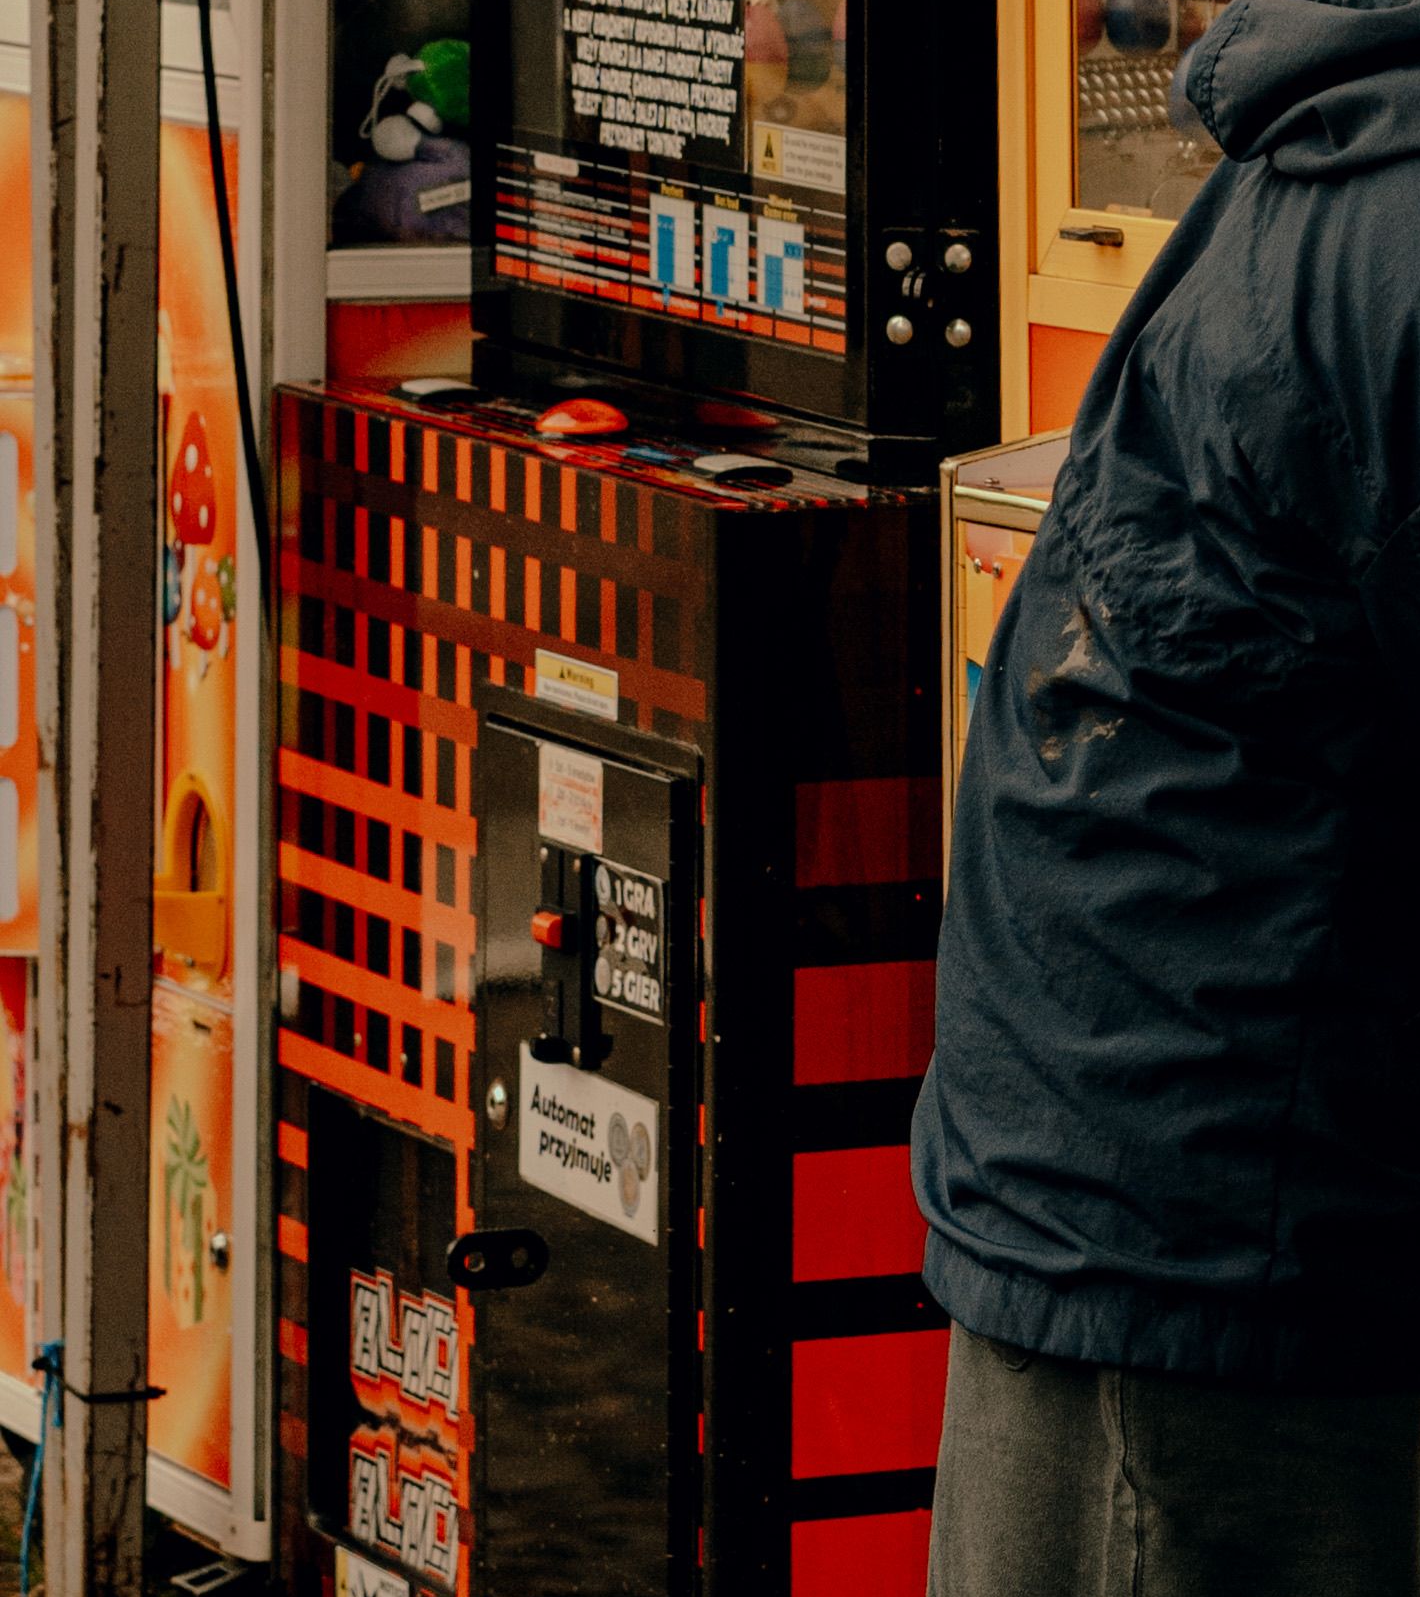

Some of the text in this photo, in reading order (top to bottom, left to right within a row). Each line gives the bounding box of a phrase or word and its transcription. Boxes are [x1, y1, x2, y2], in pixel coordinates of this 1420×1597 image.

[614, 878, 656, 919] 1 GRA
[615, 923, 659, 965] 2 GRY
[611, 969, 661, 1013] 5 GIER
[530, 1083, 597, 1141] Automat
[539, 1128, 613, 1185] przyjmuje
